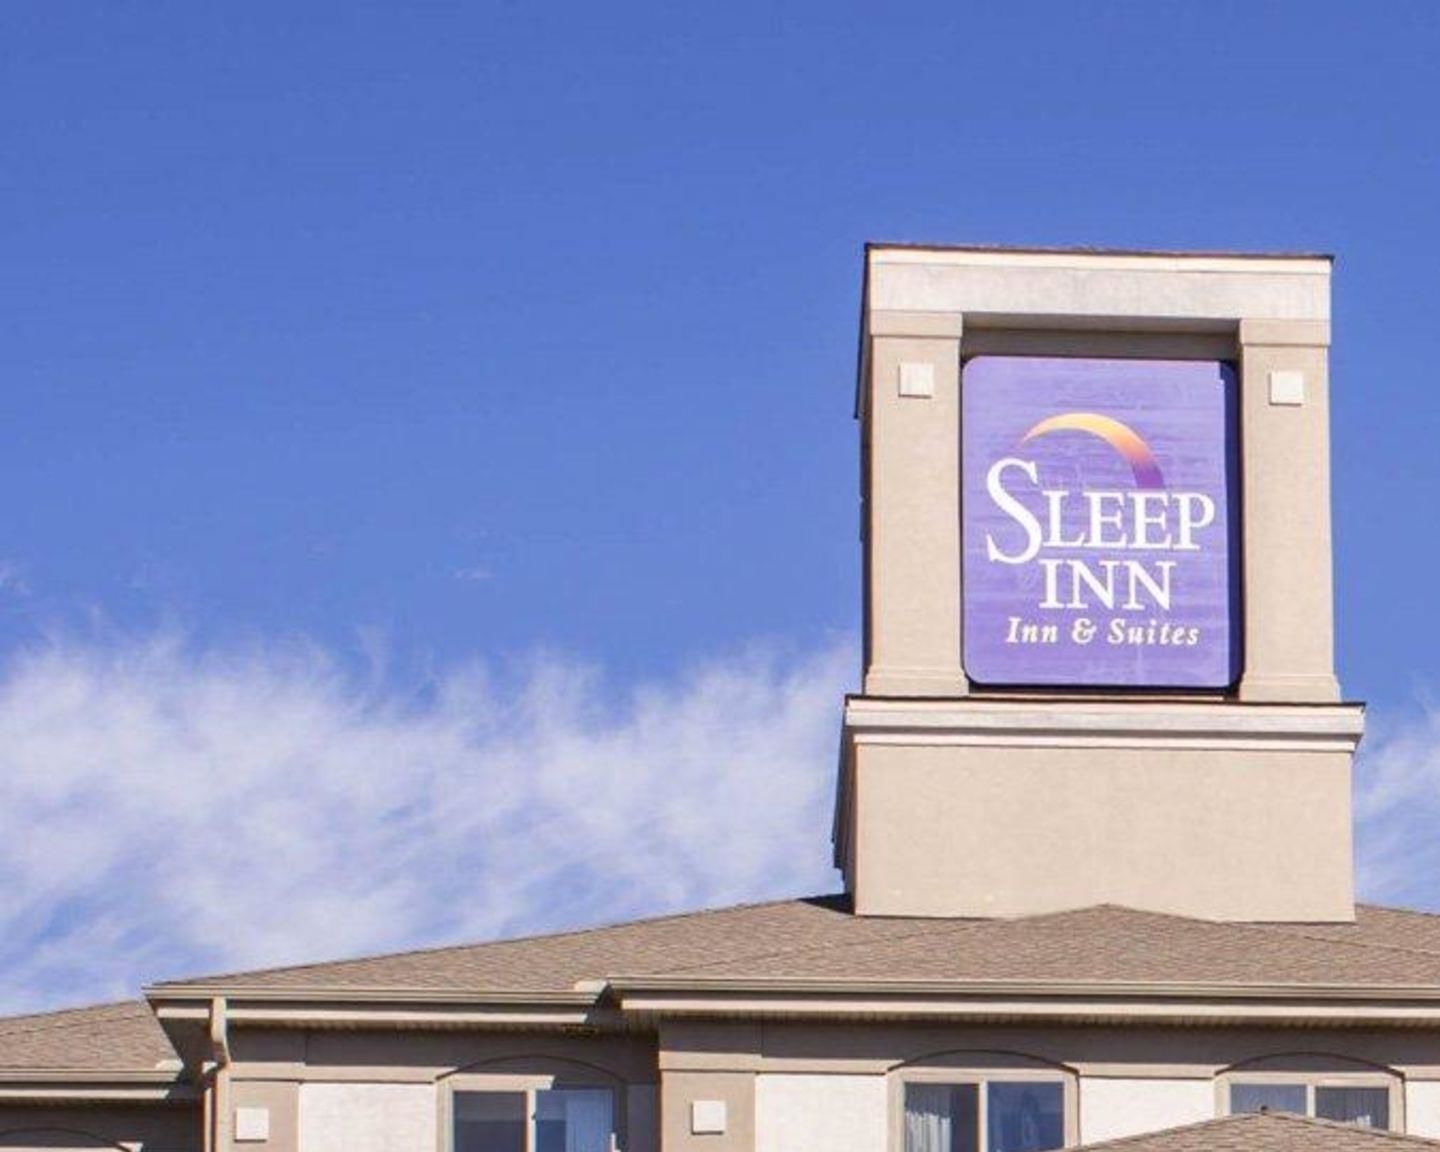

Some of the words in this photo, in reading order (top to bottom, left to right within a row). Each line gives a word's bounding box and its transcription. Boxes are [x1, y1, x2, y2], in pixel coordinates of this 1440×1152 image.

[986, 457, 1215, 564] SLEEP
[1039, 559, 1177, 611] INN
[1005, 617, 1058, 643] Inn
[1072, 618, 1096, 645] &
[1108, 618, 1199, 645] Suites
